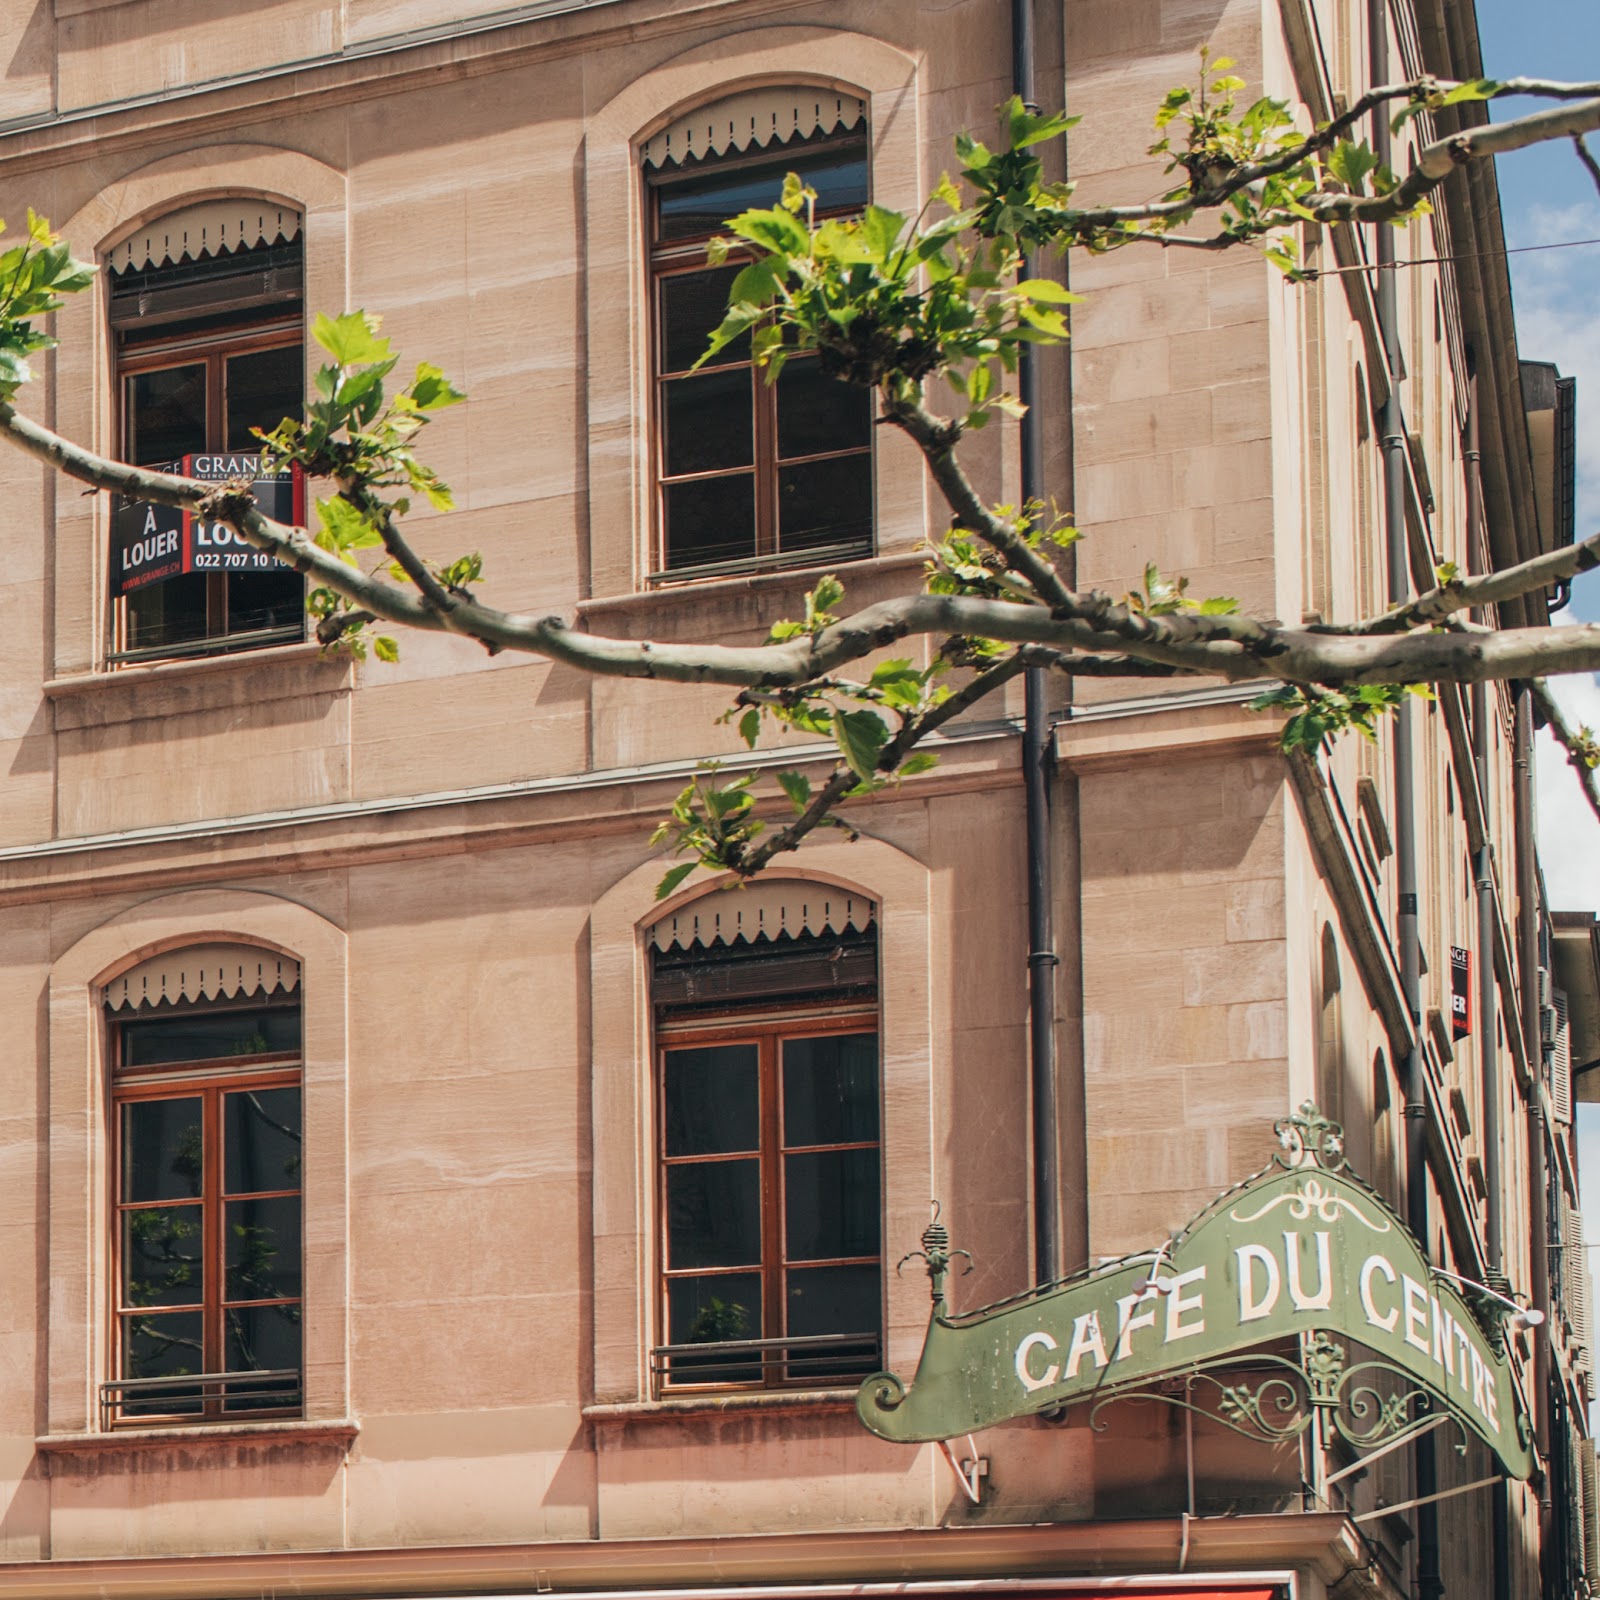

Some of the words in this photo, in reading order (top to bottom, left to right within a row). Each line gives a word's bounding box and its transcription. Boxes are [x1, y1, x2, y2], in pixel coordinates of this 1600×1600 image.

[143, 505, 157, 535] À
[122, 529, 178, 571] LOUER
[195, 554, 220, 567] 022
[223, 554, 248, 567] 707
[252, 554, 268, 567] 10
[121, 562, 181, 591] WWW.GRANGE.CH
[1014, 1264, 1206, 1393] CAFE
[1234, 1230, 1333, 1323] DU
[1360, 1254, 1500, 1434] CENTRE
